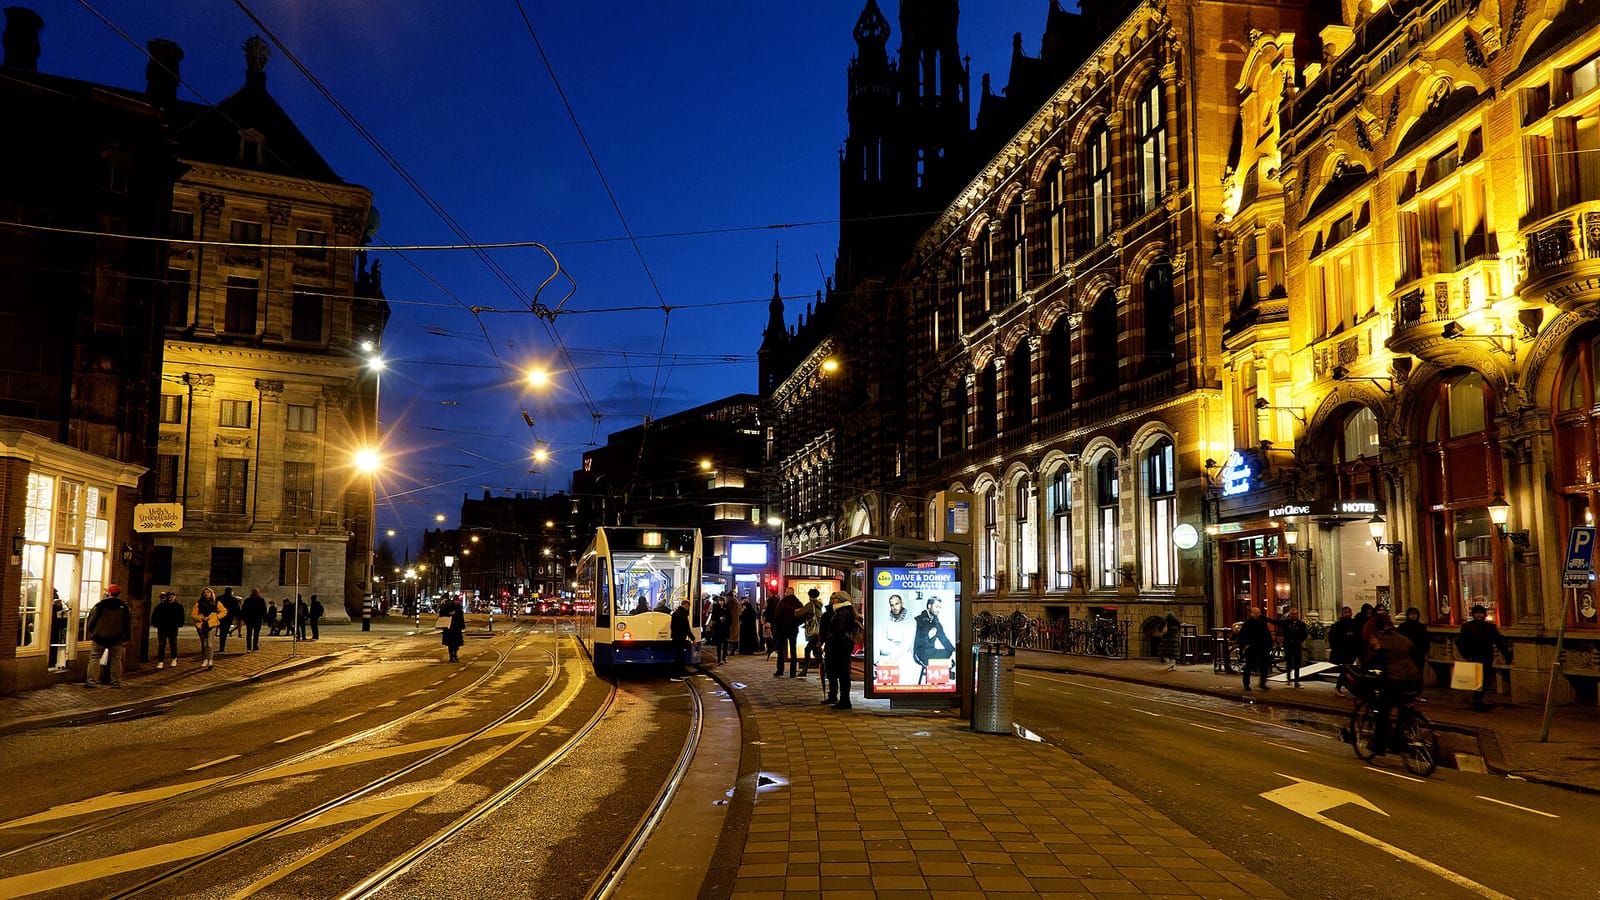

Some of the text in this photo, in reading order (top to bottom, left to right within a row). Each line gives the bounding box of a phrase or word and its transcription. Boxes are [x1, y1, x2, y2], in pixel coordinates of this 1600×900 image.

[1380, 42, 1402, 75] DIE
[1284, 504, 1311, 515] Cleve
[1342, 502, 1376, 513] HOTEL
[1573, 530, 1591, 554] P
[894, 574, 952, 582] DAVE & DONNY
